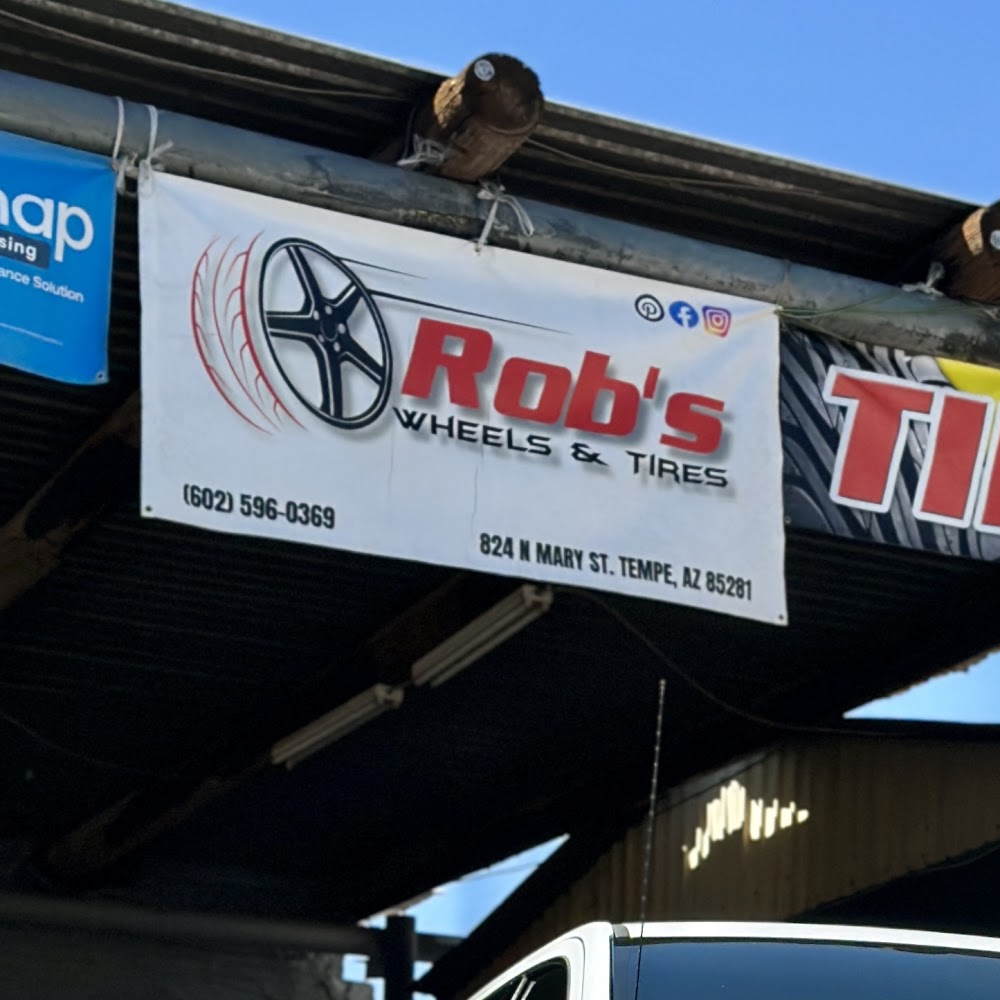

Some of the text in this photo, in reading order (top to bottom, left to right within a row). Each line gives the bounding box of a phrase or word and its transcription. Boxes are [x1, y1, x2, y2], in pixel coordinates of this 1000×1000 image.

[32, 275, 84, 303] Solution
[401, 317, 725, 455] Rob's
[392, 406, 729, 488] WHEELS & TIRES
[183, 483, 335, 529] (602) 596-0369
[480, 532, 752, 601] 824 N MARY ST. TEMPE, AZ 85281
